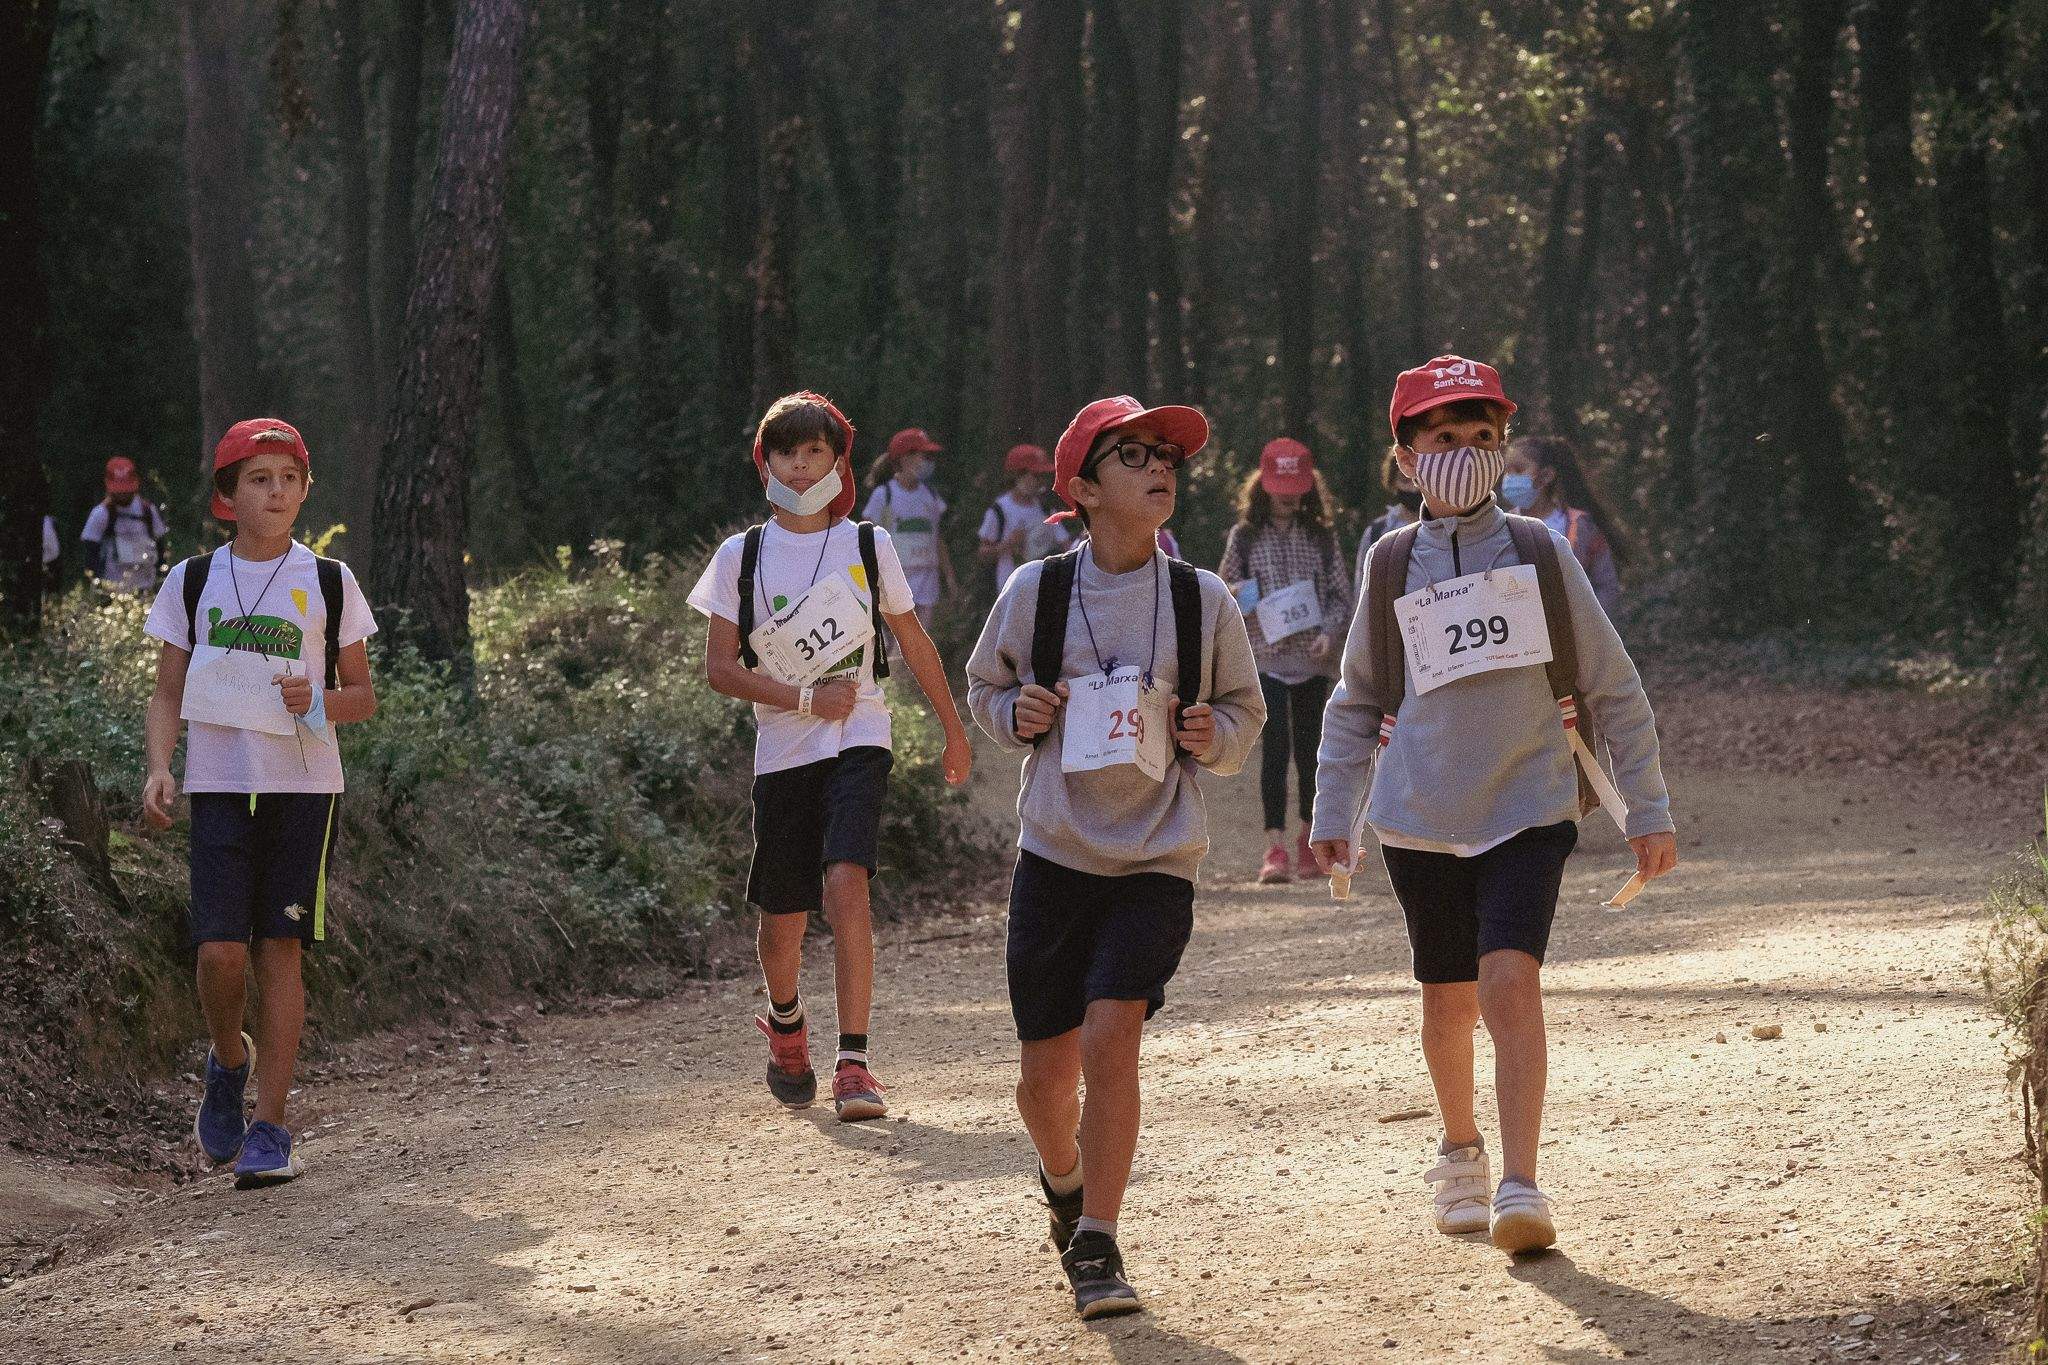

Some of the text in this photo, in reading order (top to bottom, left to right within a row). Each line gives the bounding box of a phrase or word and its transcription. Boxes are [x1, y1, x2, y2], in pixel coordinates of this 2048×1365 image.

[1431, 360, 1476, 378] TOT
[1433, 376, 1484, 390] Sant Cugat
[1434, 583, 1475, 603] Marxa”
[1280, 603, 1310, 625] 263
[794, 617, 845, 661] 312
[1444, 615, 1509, 656] 299
